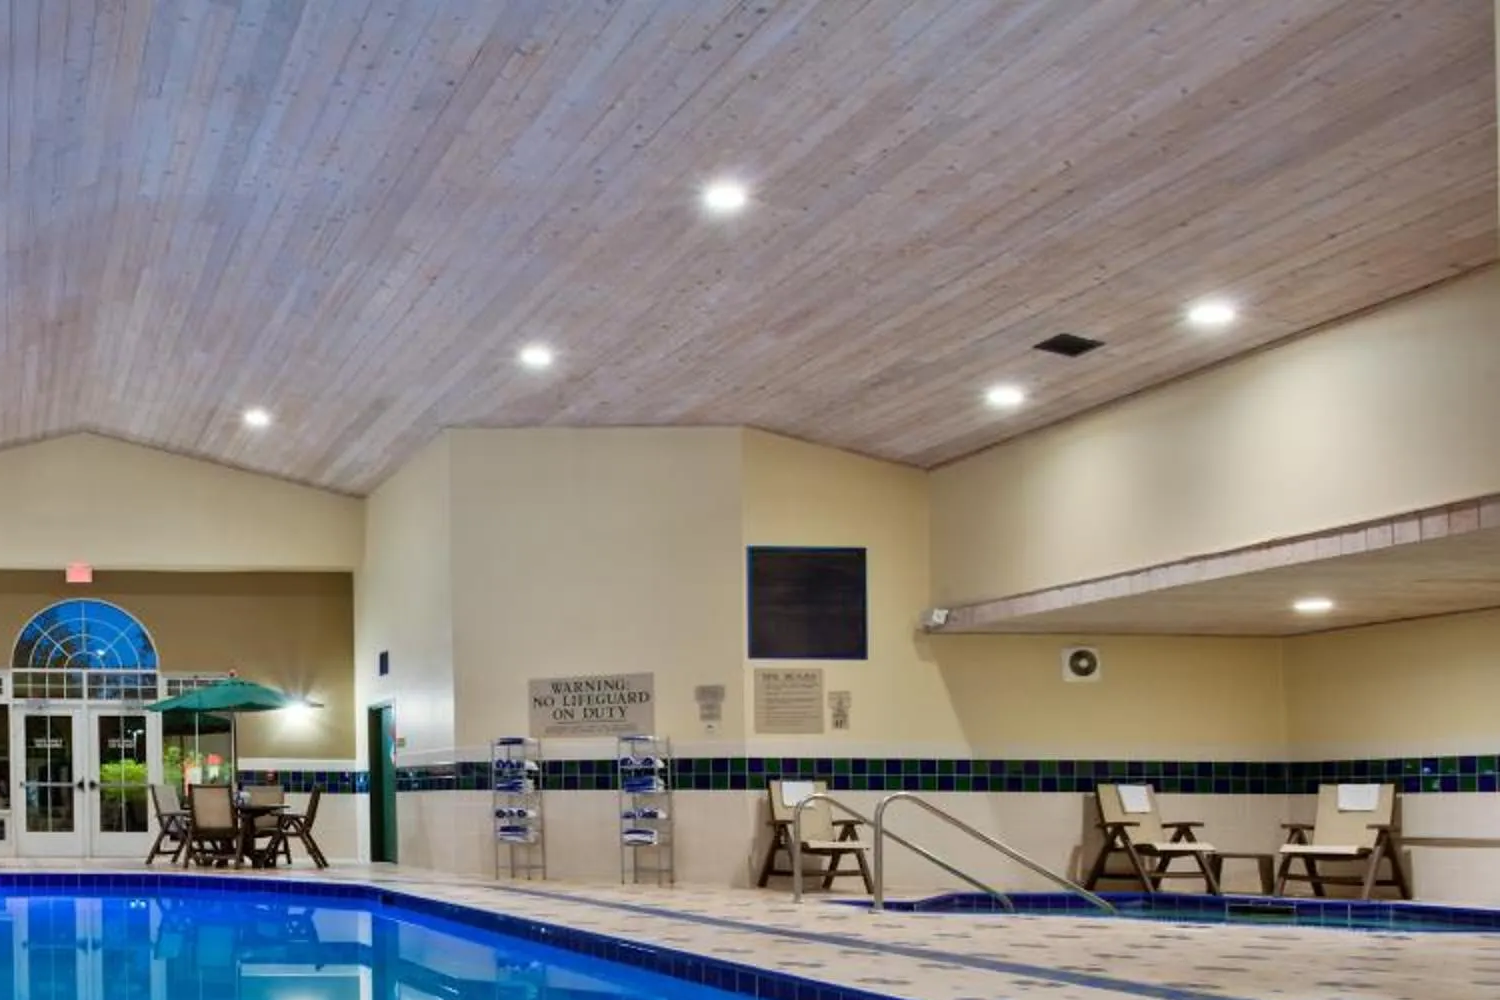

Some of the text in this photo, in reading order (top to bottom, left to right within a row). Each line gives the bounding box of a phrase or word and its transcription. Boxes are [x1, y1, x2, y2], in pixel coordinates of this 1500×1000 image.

[533, 691, 650, 708] NO LIFEGUARD
[552, 706, 627, 720] ON DUTY
